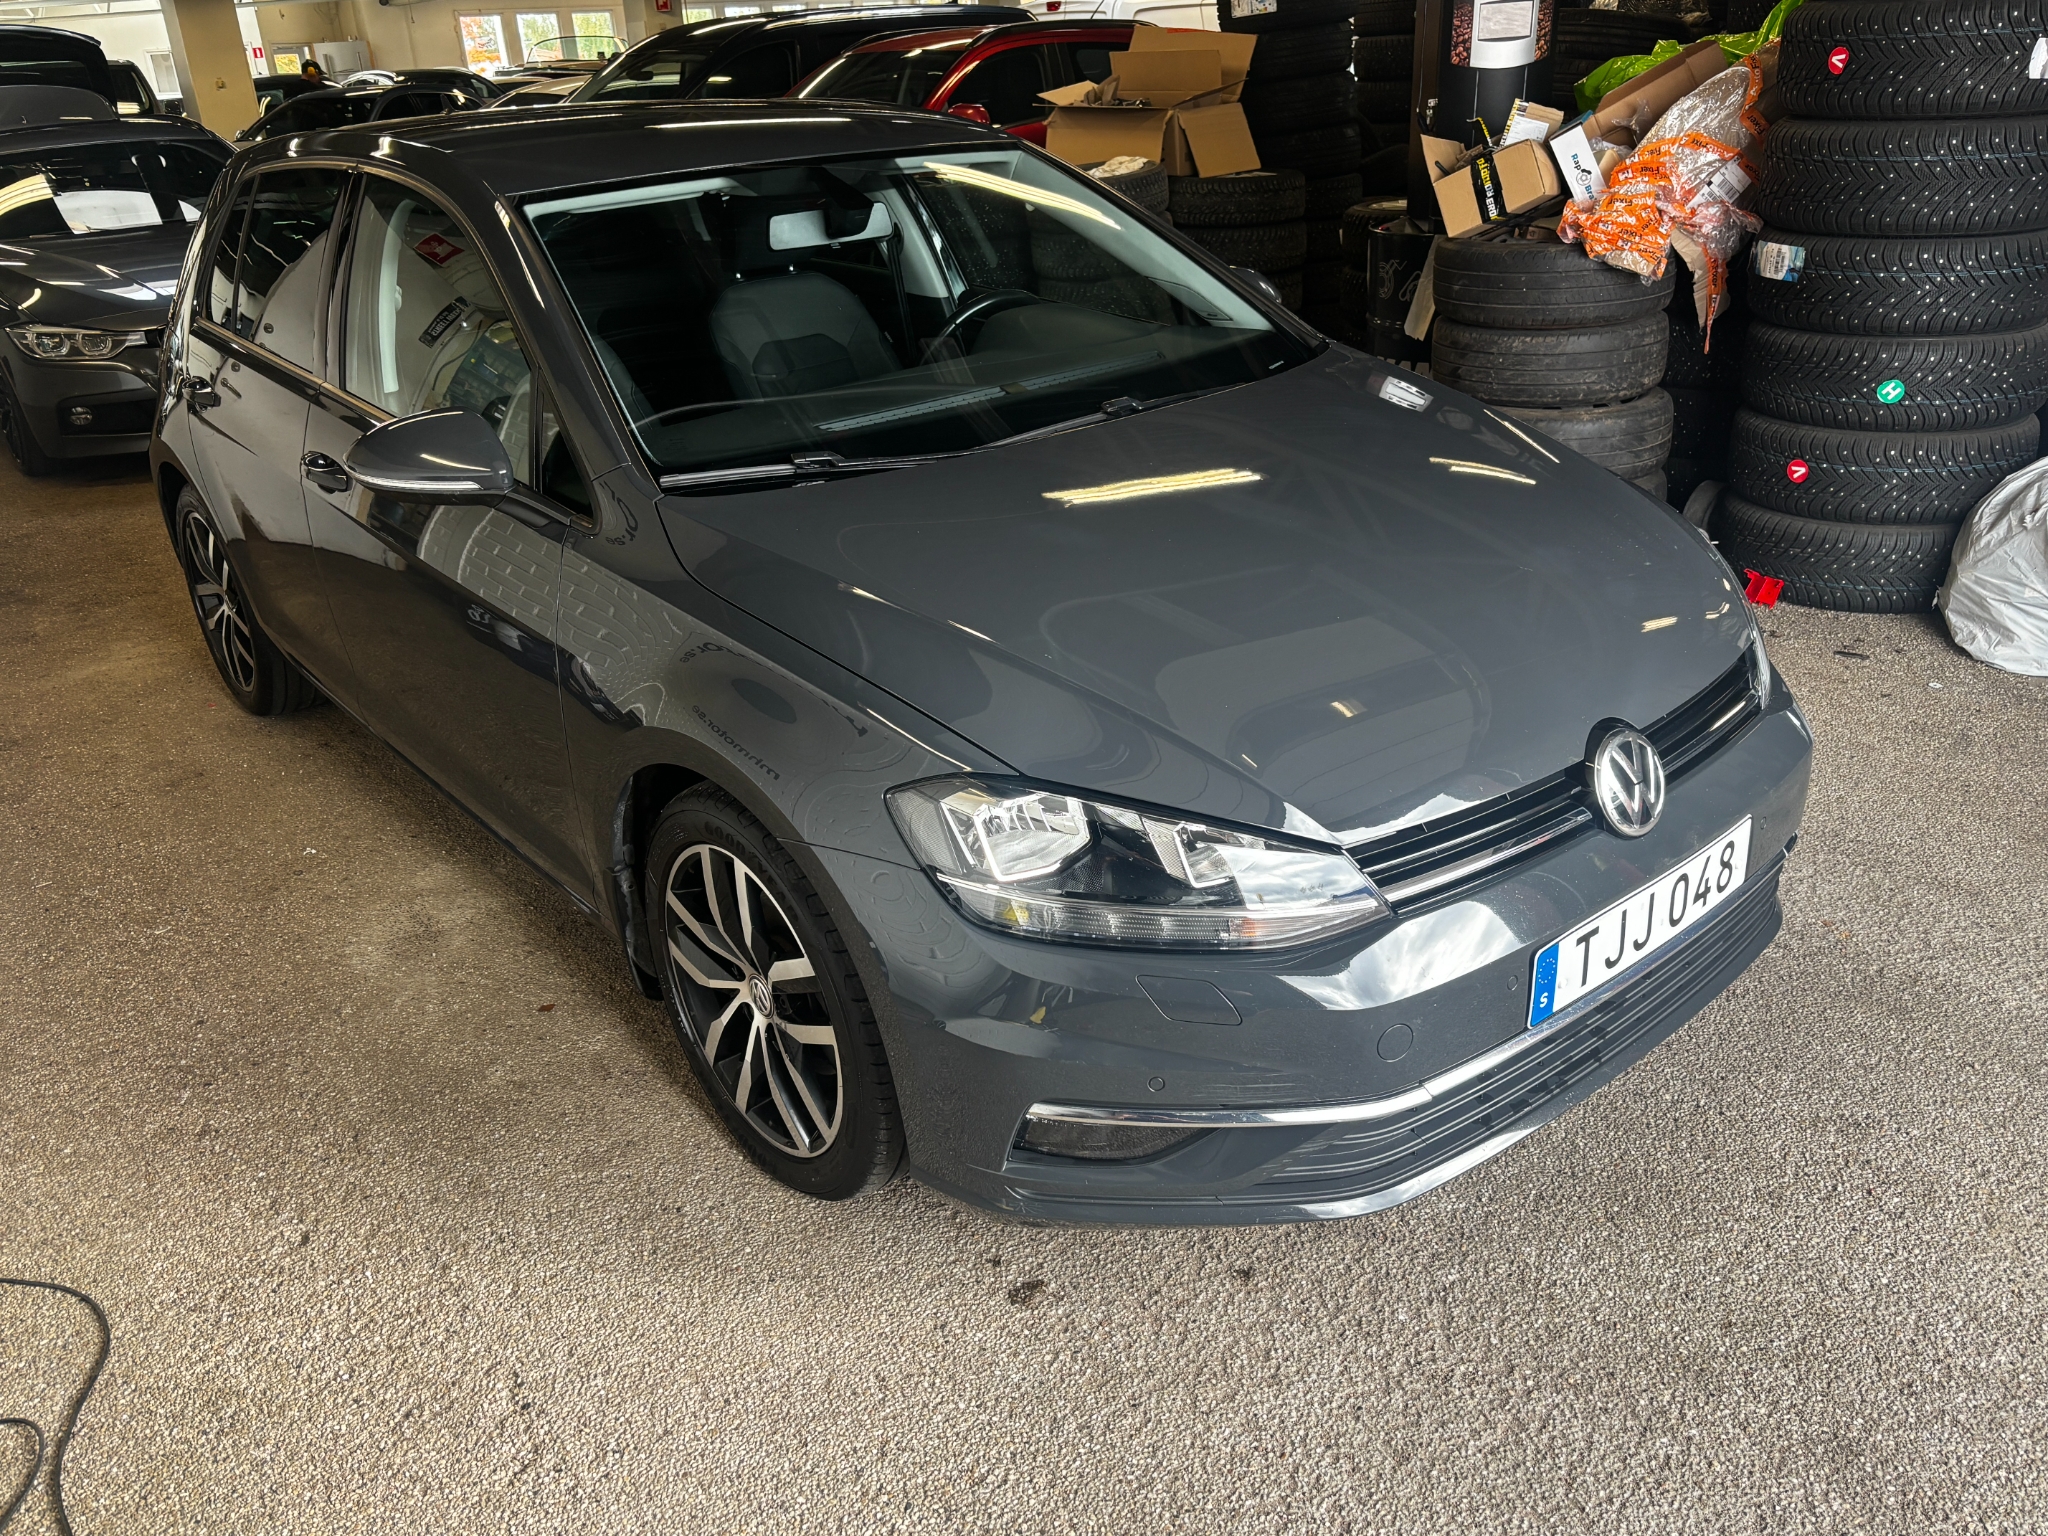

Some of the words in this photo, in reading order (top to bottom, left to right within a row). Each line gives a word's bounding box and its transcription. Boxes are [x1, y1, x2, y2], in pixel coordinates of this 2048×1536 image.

[1747, 114, 1765, 135] Fixer
[1571, 153, 1582, 171] Rap
[1585, 185, 1597, 201] Bra
[1607, 196, 1653, 207] AutoFixer
[1576, 893, 1655, 988] TJJ
[1668, 840, 1735, 928] 048
[1540, 992, 1548, 1008] S
